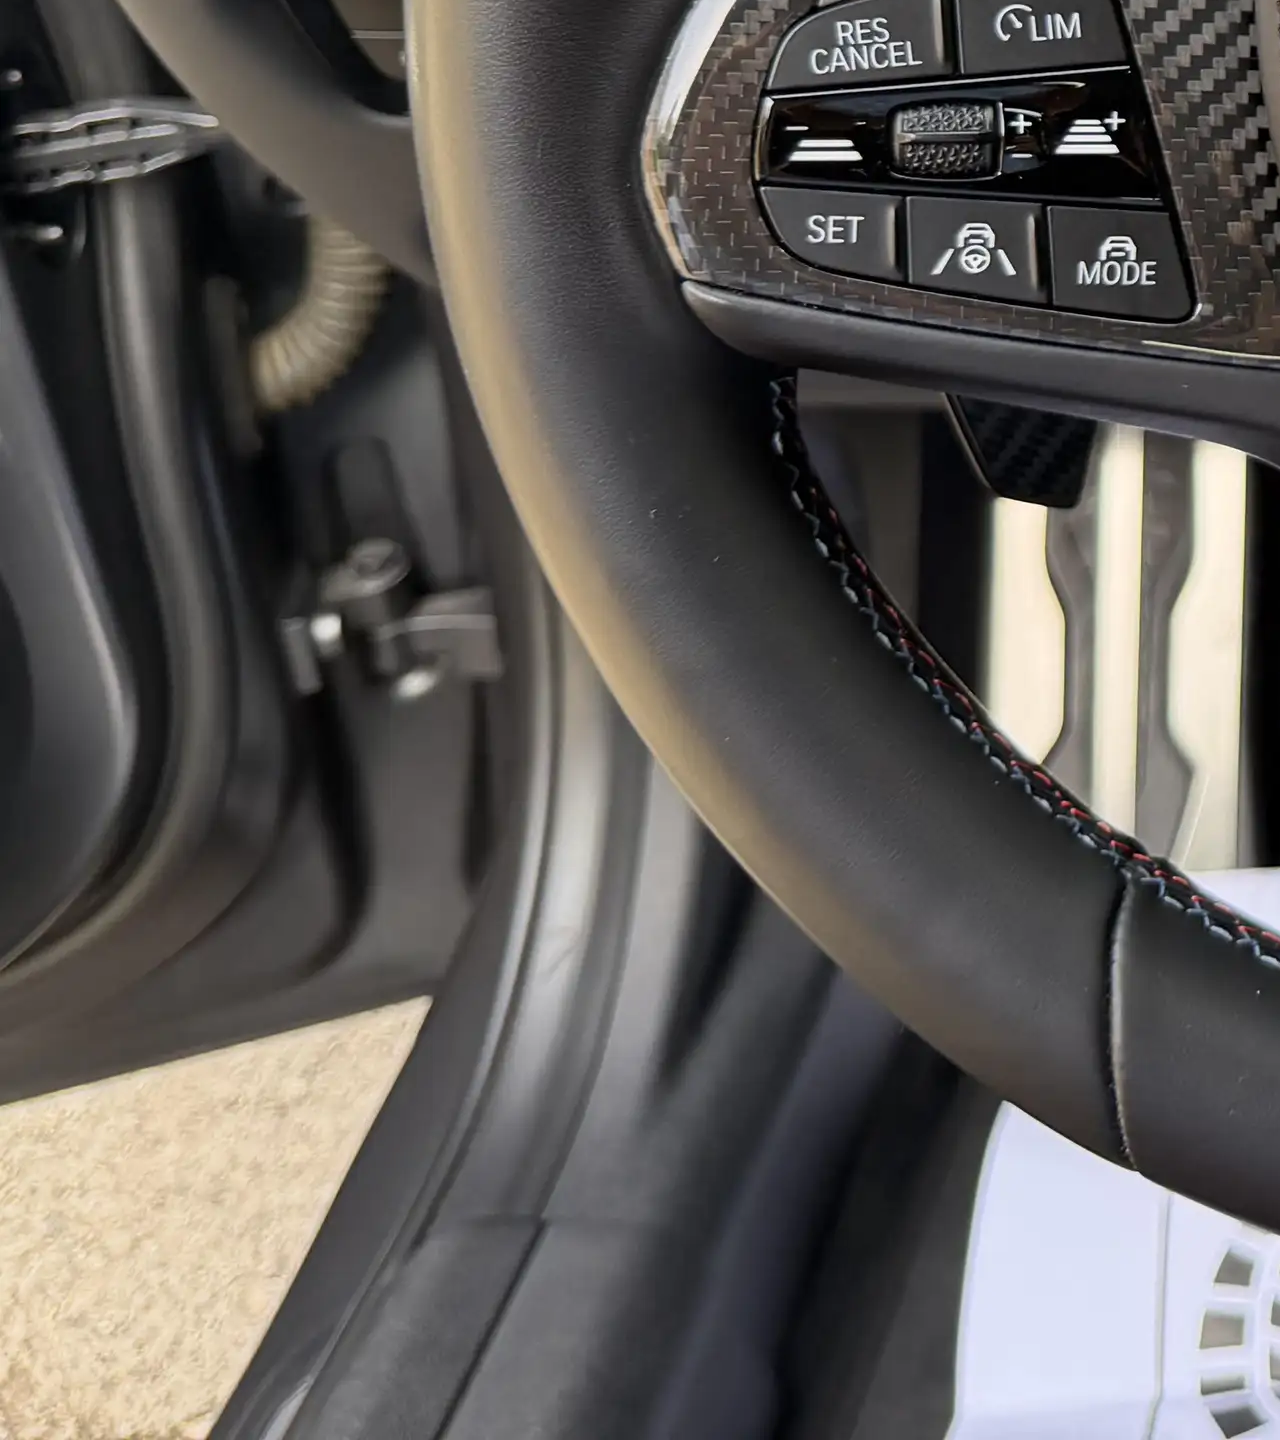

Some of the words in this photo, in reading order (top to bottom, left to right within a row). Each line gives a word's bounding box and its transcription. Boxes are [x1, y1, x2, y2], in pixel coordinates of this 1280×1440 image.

[835, 17, 890, 47] RES
[1032, 12, 1082, 42] LIM
[811, 40, 922, 75] CANCEL
[807, 215, 864, 244] SET
[1077, 261, 1156, 286] MODE
